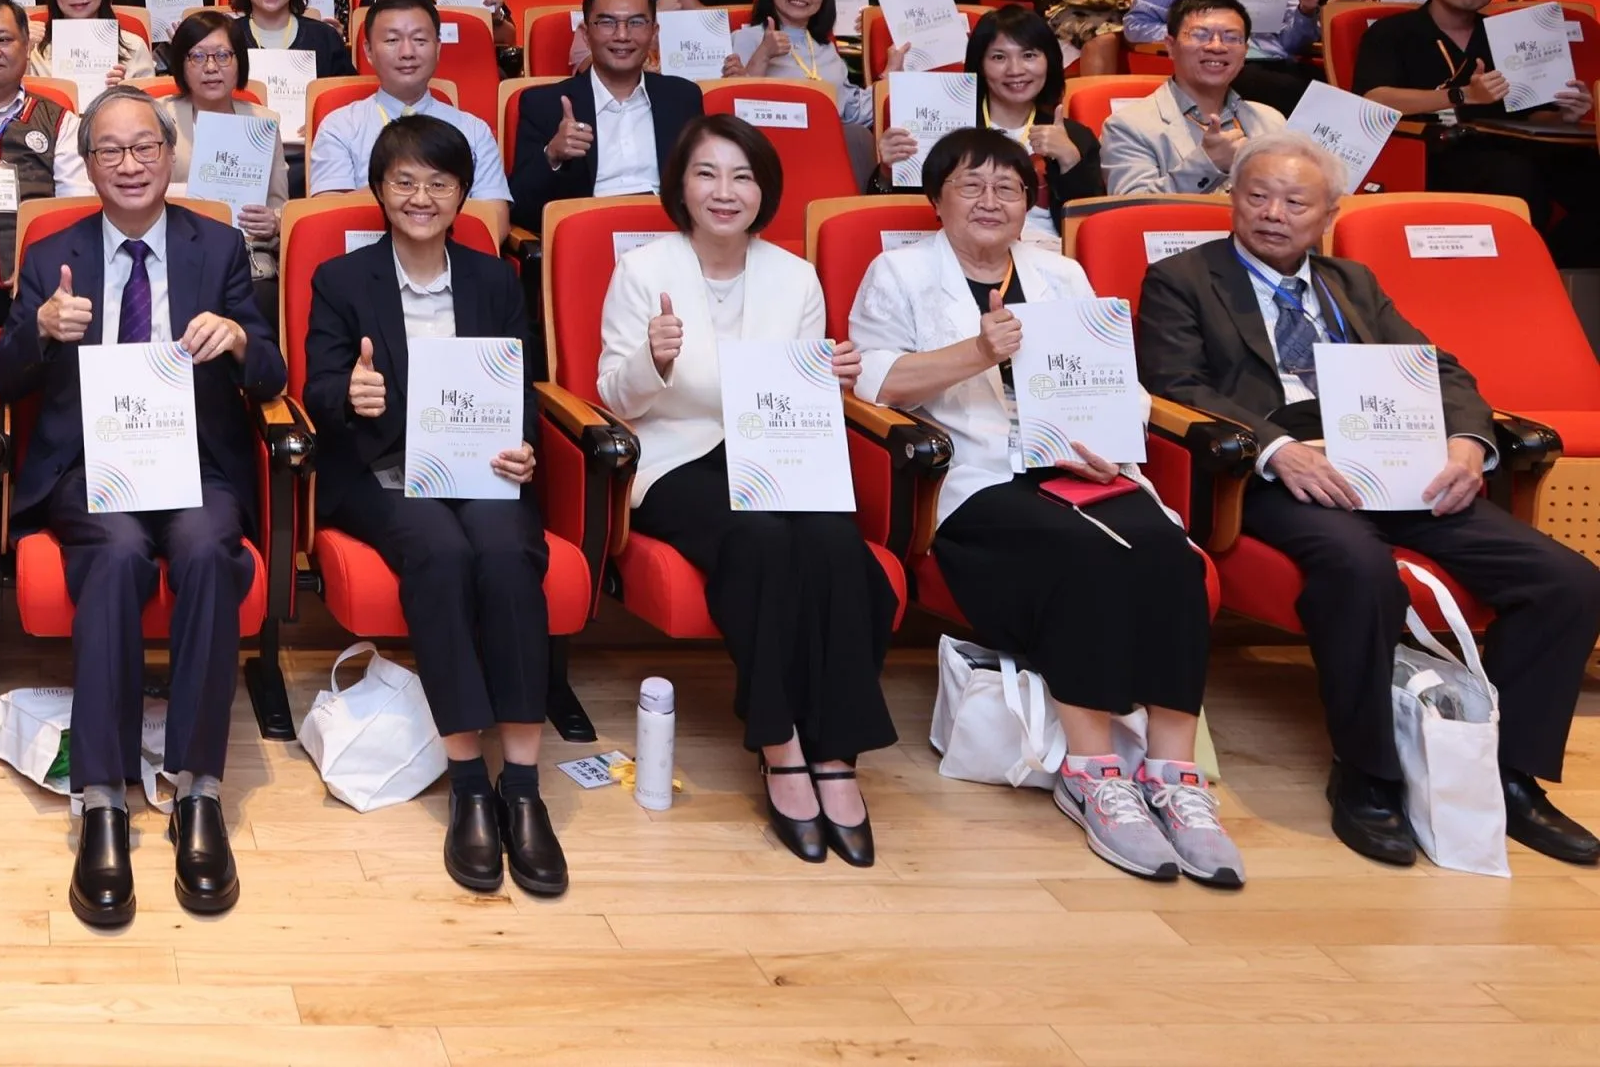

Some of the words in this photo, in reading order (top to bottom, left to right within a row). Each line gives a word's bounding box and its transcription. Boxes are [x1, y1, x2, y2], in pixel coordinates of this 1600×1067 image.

[1047, 354, 1082, 373] 國家
[114, 394, 147, 415] 國家
[441, 389, 475, 410] 國家
[756, 392, 791, 413] 國家
[1359, 394, 1396, 415] 國家
